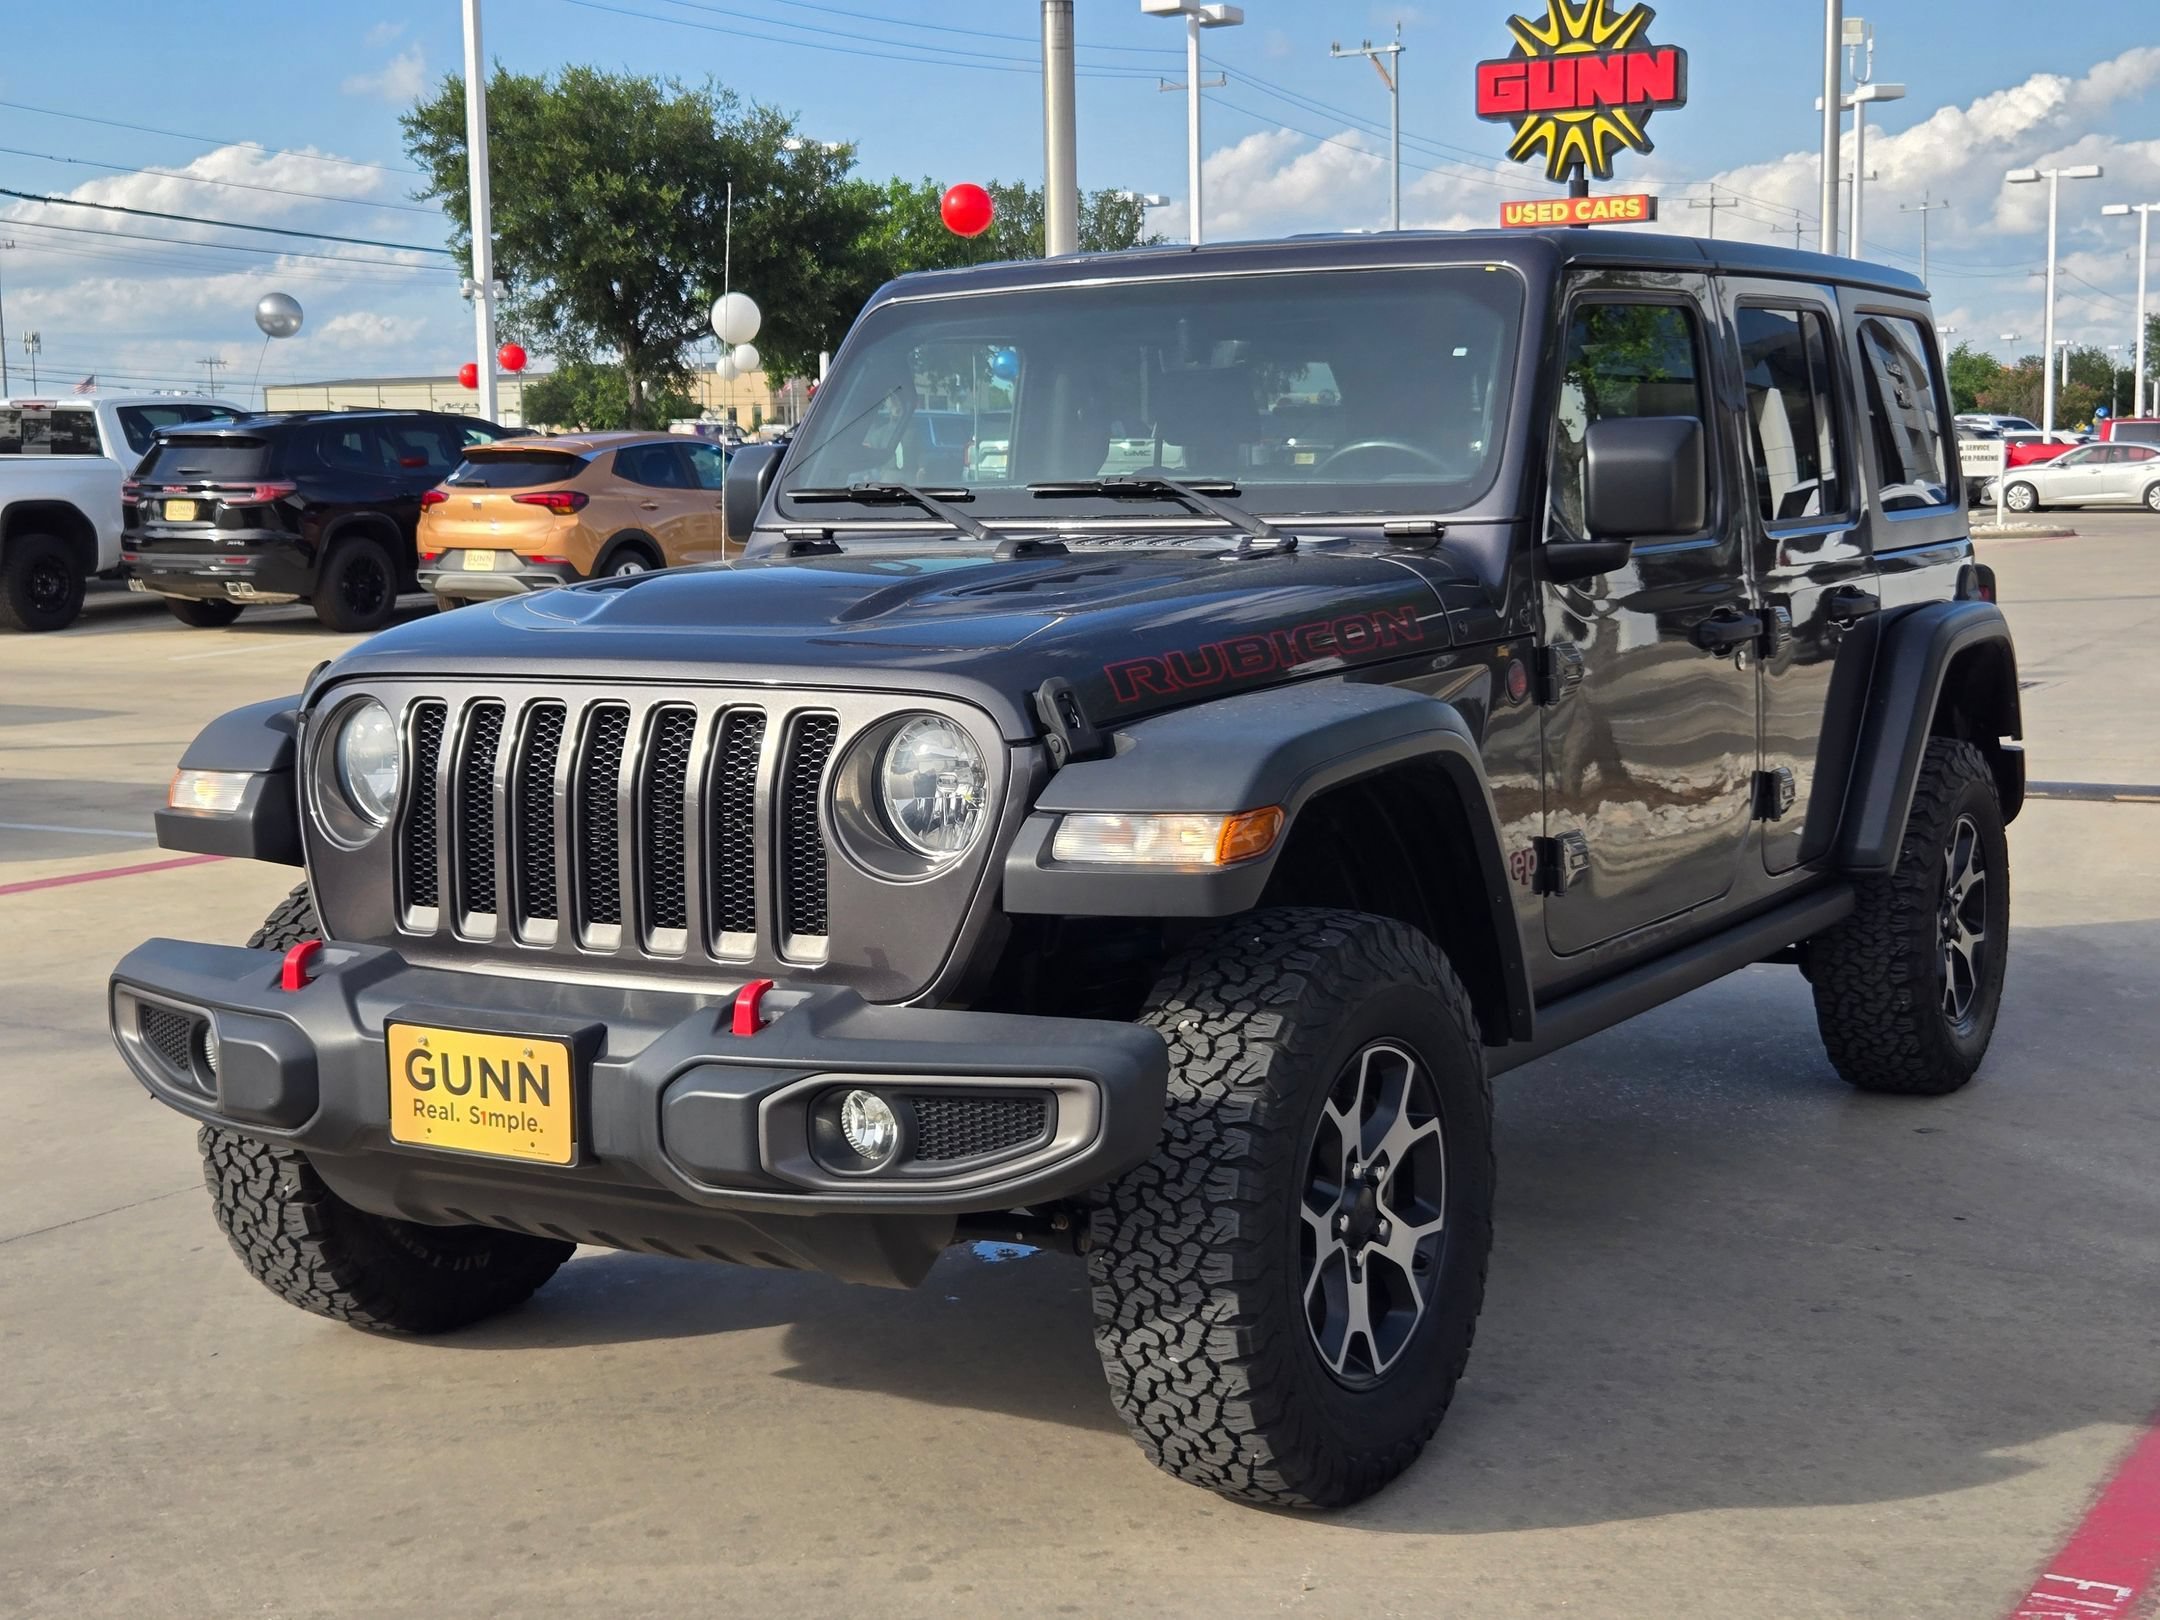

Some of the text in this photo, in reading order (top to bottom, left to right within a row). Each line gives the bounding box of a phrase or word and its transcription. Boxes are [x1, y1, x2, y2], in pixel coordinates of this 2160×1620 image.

[1478, 49, 1677, 115] GUNN
[1505, 198, 1641, 224] USED CARS
[1103, 605, 1424, 702] RUBICON
[405, 1048, 551, 1107] GUNN
[413, 1098, 460, 1123] Real.
